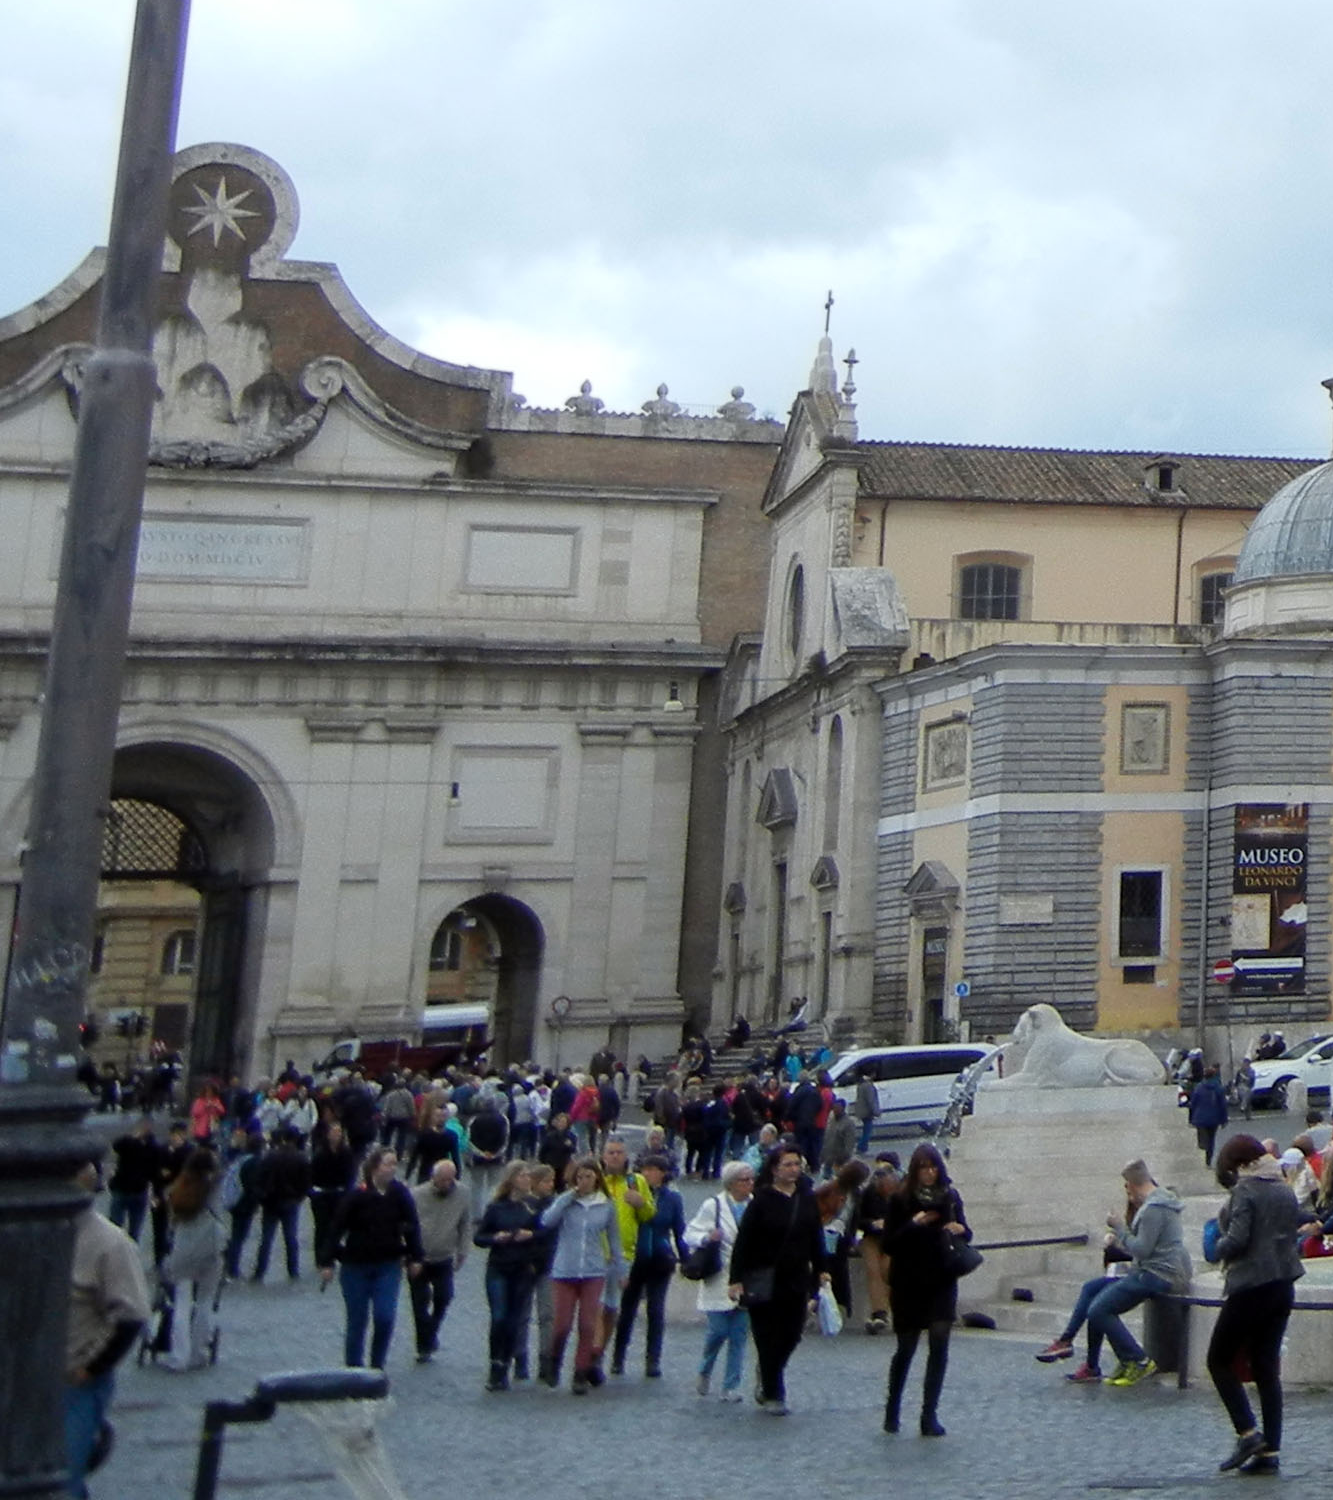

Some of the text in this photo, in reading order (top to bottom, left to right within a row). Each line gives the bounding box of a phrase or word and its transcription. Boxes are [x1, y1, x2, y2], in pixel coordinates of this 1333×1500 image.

[1239, 848, 1304, 864] MUSEO
[1239, 866, 1303, 876] LEONARDO
[1245, 877, 1297, 886] DA VINCI
